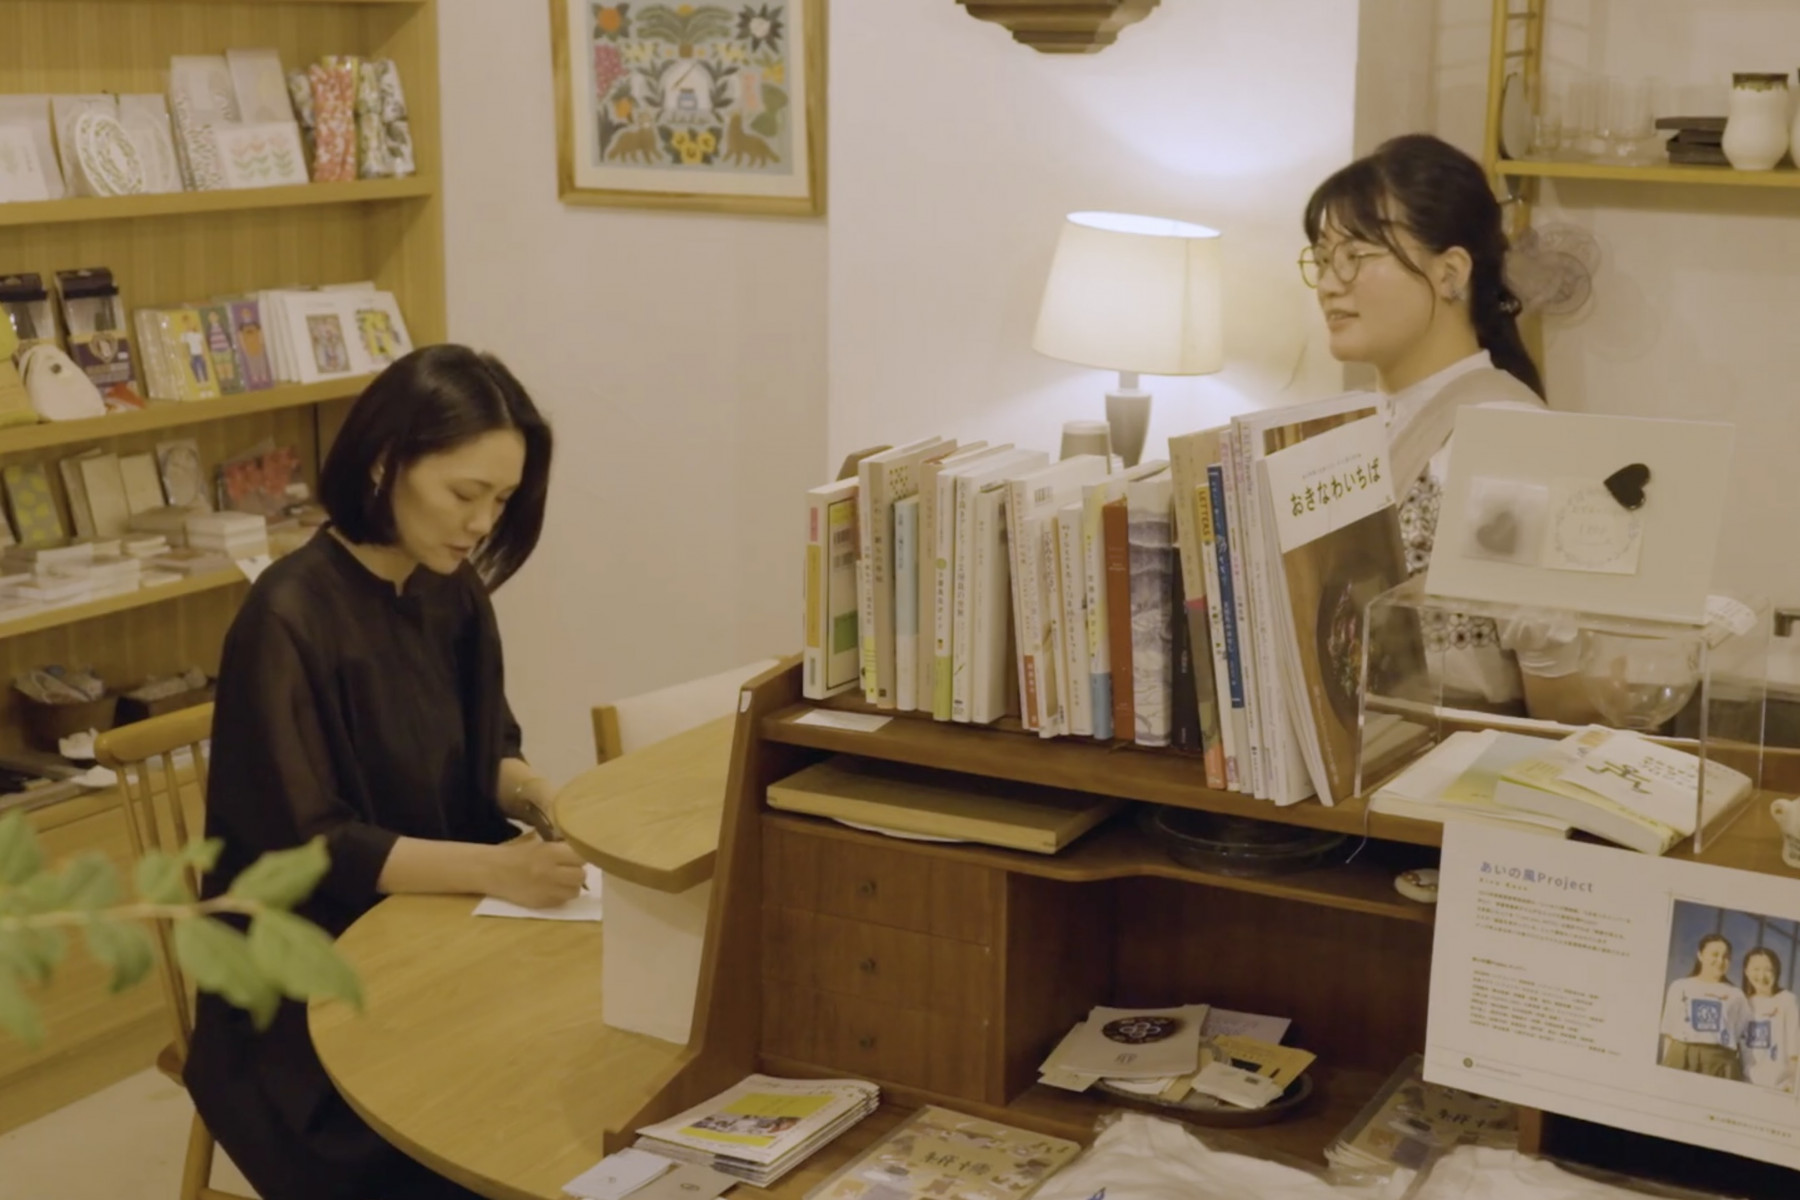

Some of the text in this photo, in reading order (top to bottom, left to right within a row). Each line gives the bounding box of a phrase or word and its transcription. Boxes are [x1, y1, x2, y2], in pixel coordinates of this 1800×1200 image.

[1289, 456, 1382, 518] おきなわいちば
[1199, 490, 1212, 538] LETTERS
[1479, 860, 1595, 893] あいの風Project
